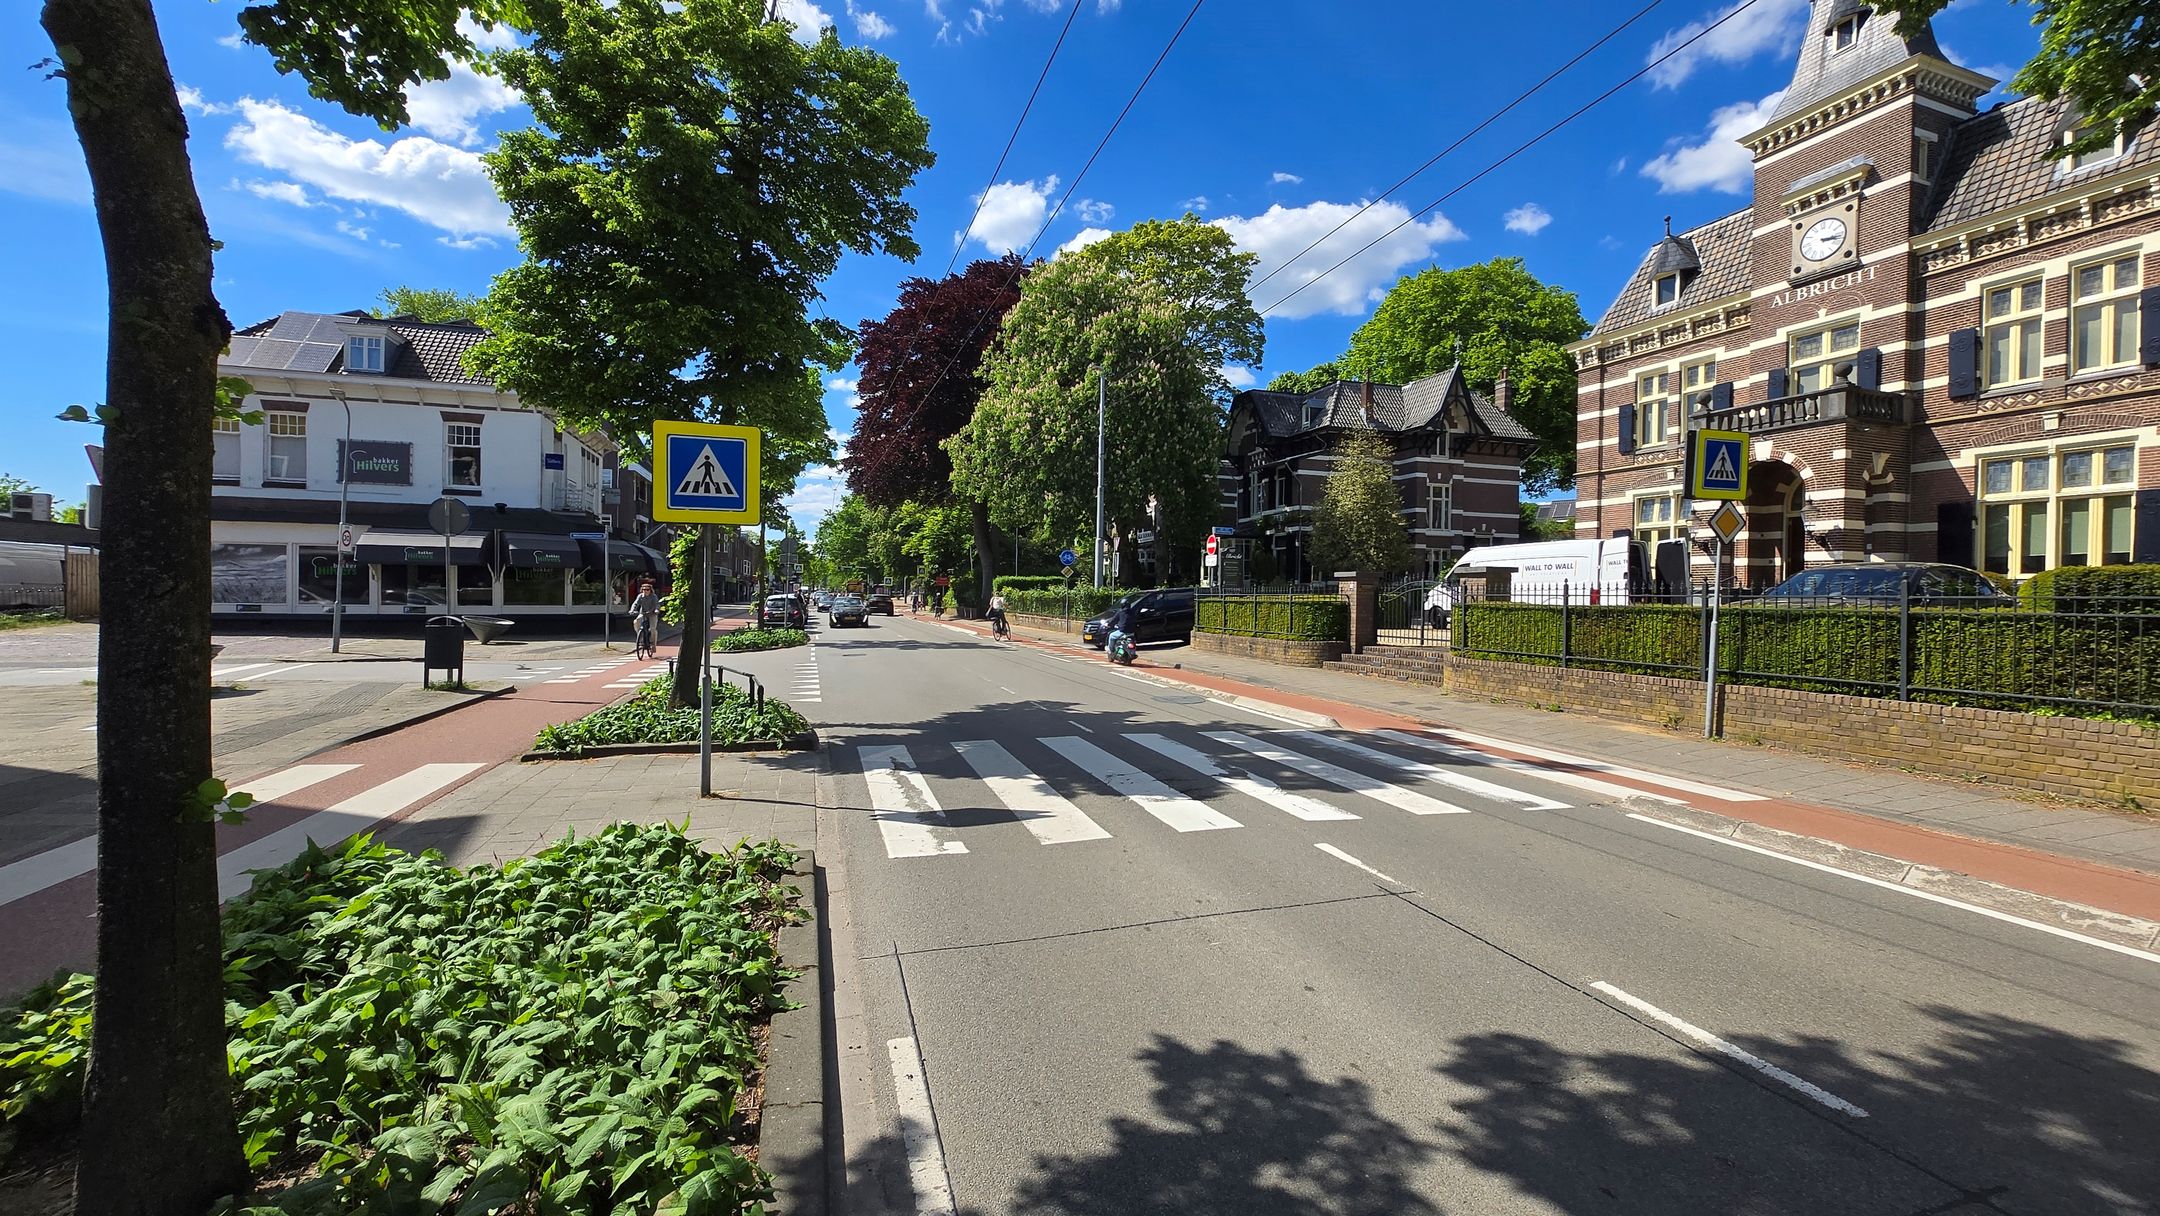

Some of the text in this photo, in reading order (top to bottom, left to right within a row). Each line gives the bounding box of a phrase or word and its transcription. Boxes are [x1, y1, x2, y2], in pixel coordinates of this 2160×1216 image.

[1770, 264, 1880, 309] ALBRICHT
[356, 460, 400, 472] Hilvers
[1524, 564, 1542, 572] WALL
